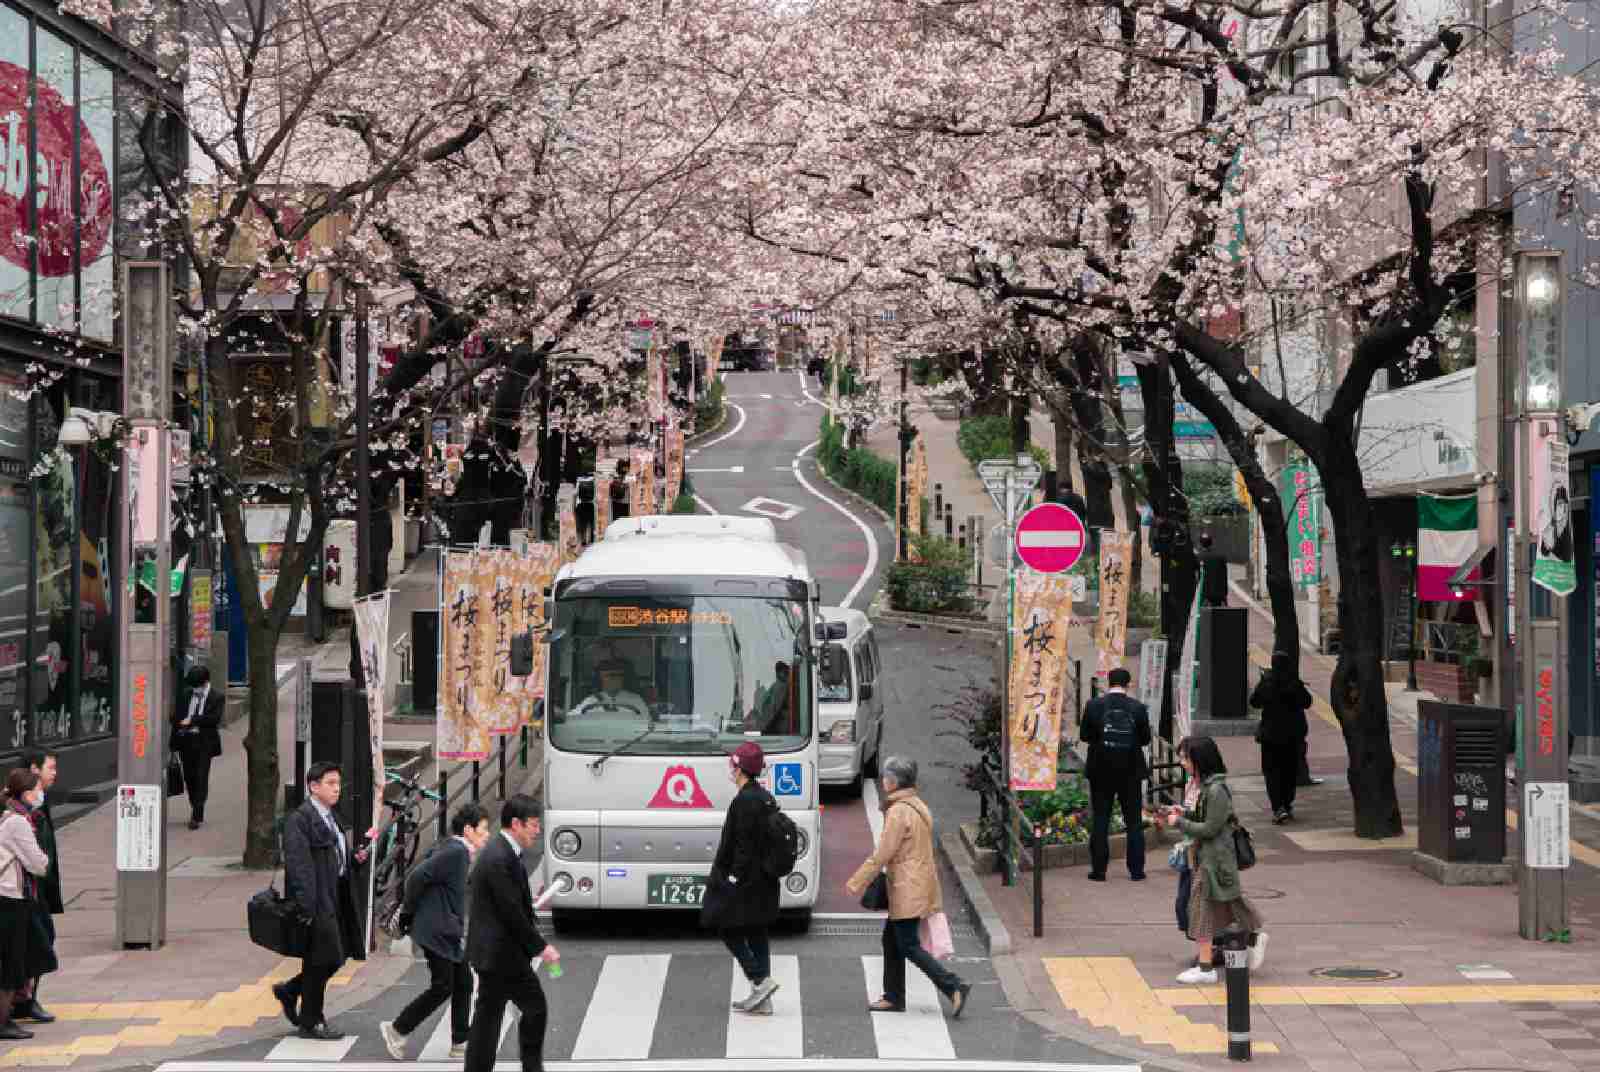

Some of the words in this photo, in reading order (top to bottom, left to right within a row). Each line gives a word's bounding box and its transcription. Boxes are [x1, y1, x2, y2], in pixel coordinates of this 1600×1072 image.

[1103, 558, 1125, 640] 桜まつり
[451, 589, 479, 714] 桜まつり
[1023, 614, 1056, 742] 桜まつり
[666, 773, 695, 804] Q
